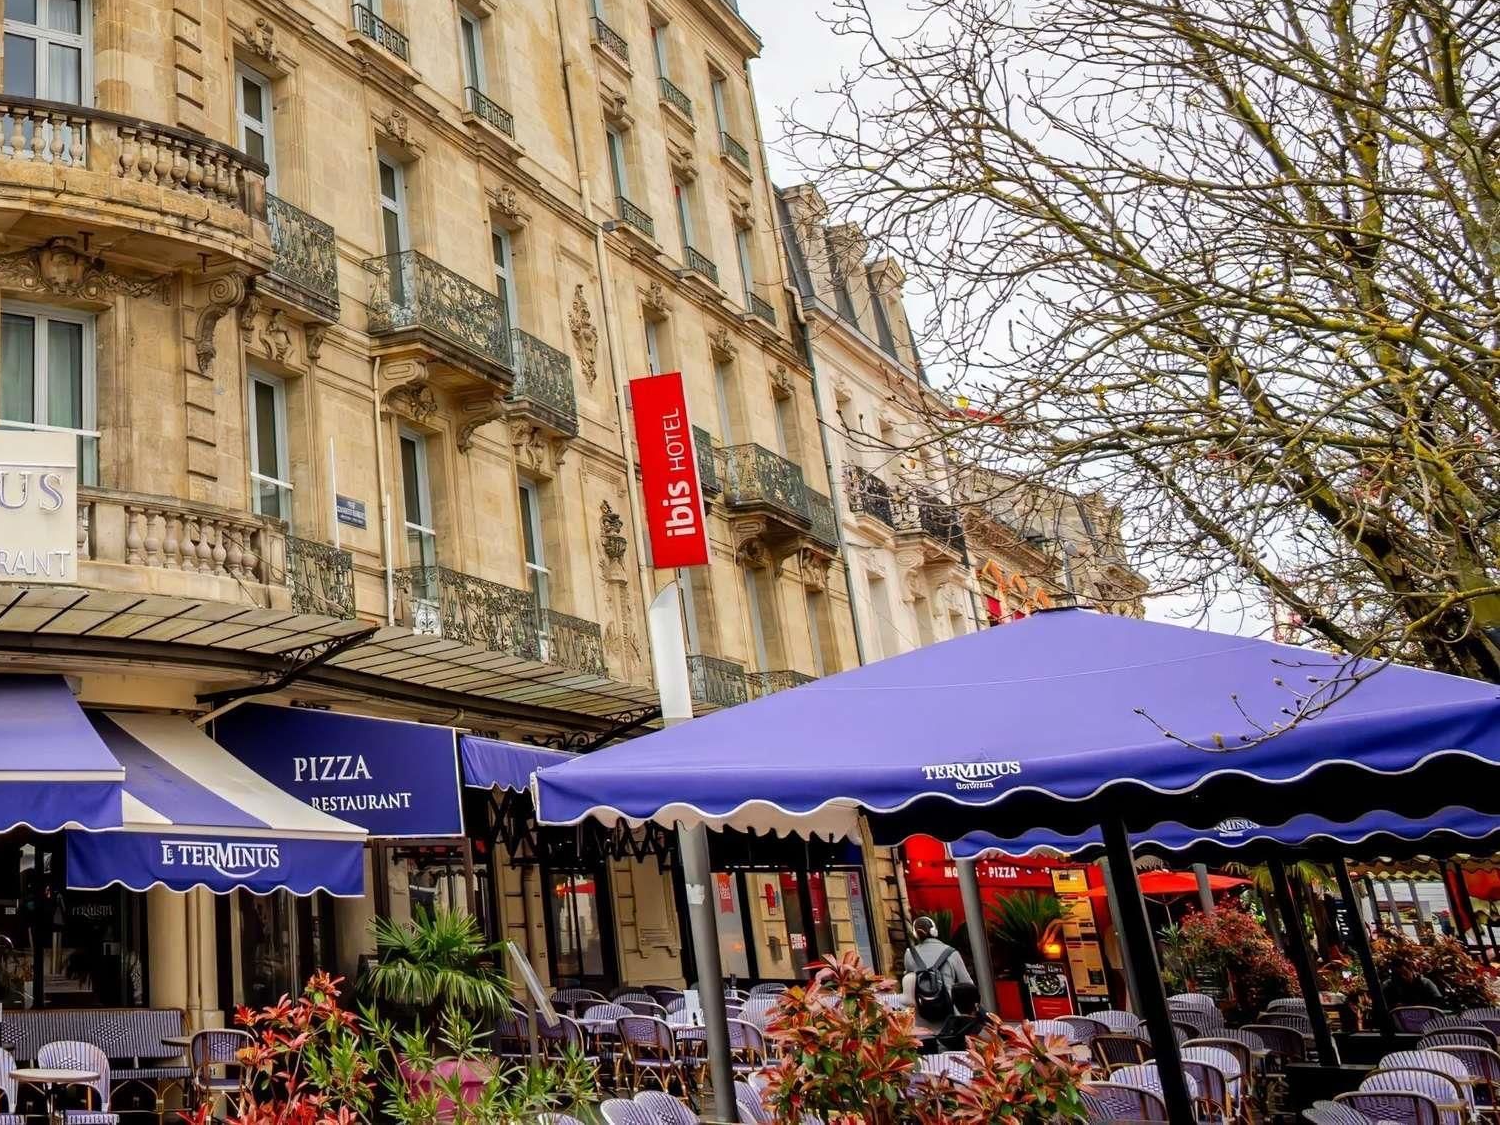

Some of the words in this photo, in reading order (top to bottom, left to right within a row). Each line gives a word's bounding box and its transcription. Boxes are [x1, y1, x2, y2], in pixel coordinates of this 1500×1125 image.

[662, 408, 686, 472] HOTEL
[662, 480, 697, 538] ibis
[293, 755, 372, 782] PIZZA
[921, 761, 1021, 783] TERMINUS
[311, 793, 411, 812] RESTAURANT
[178, 843, 280, 878] TERMINUS
[988, 866, 1018, 879] PIZZA
